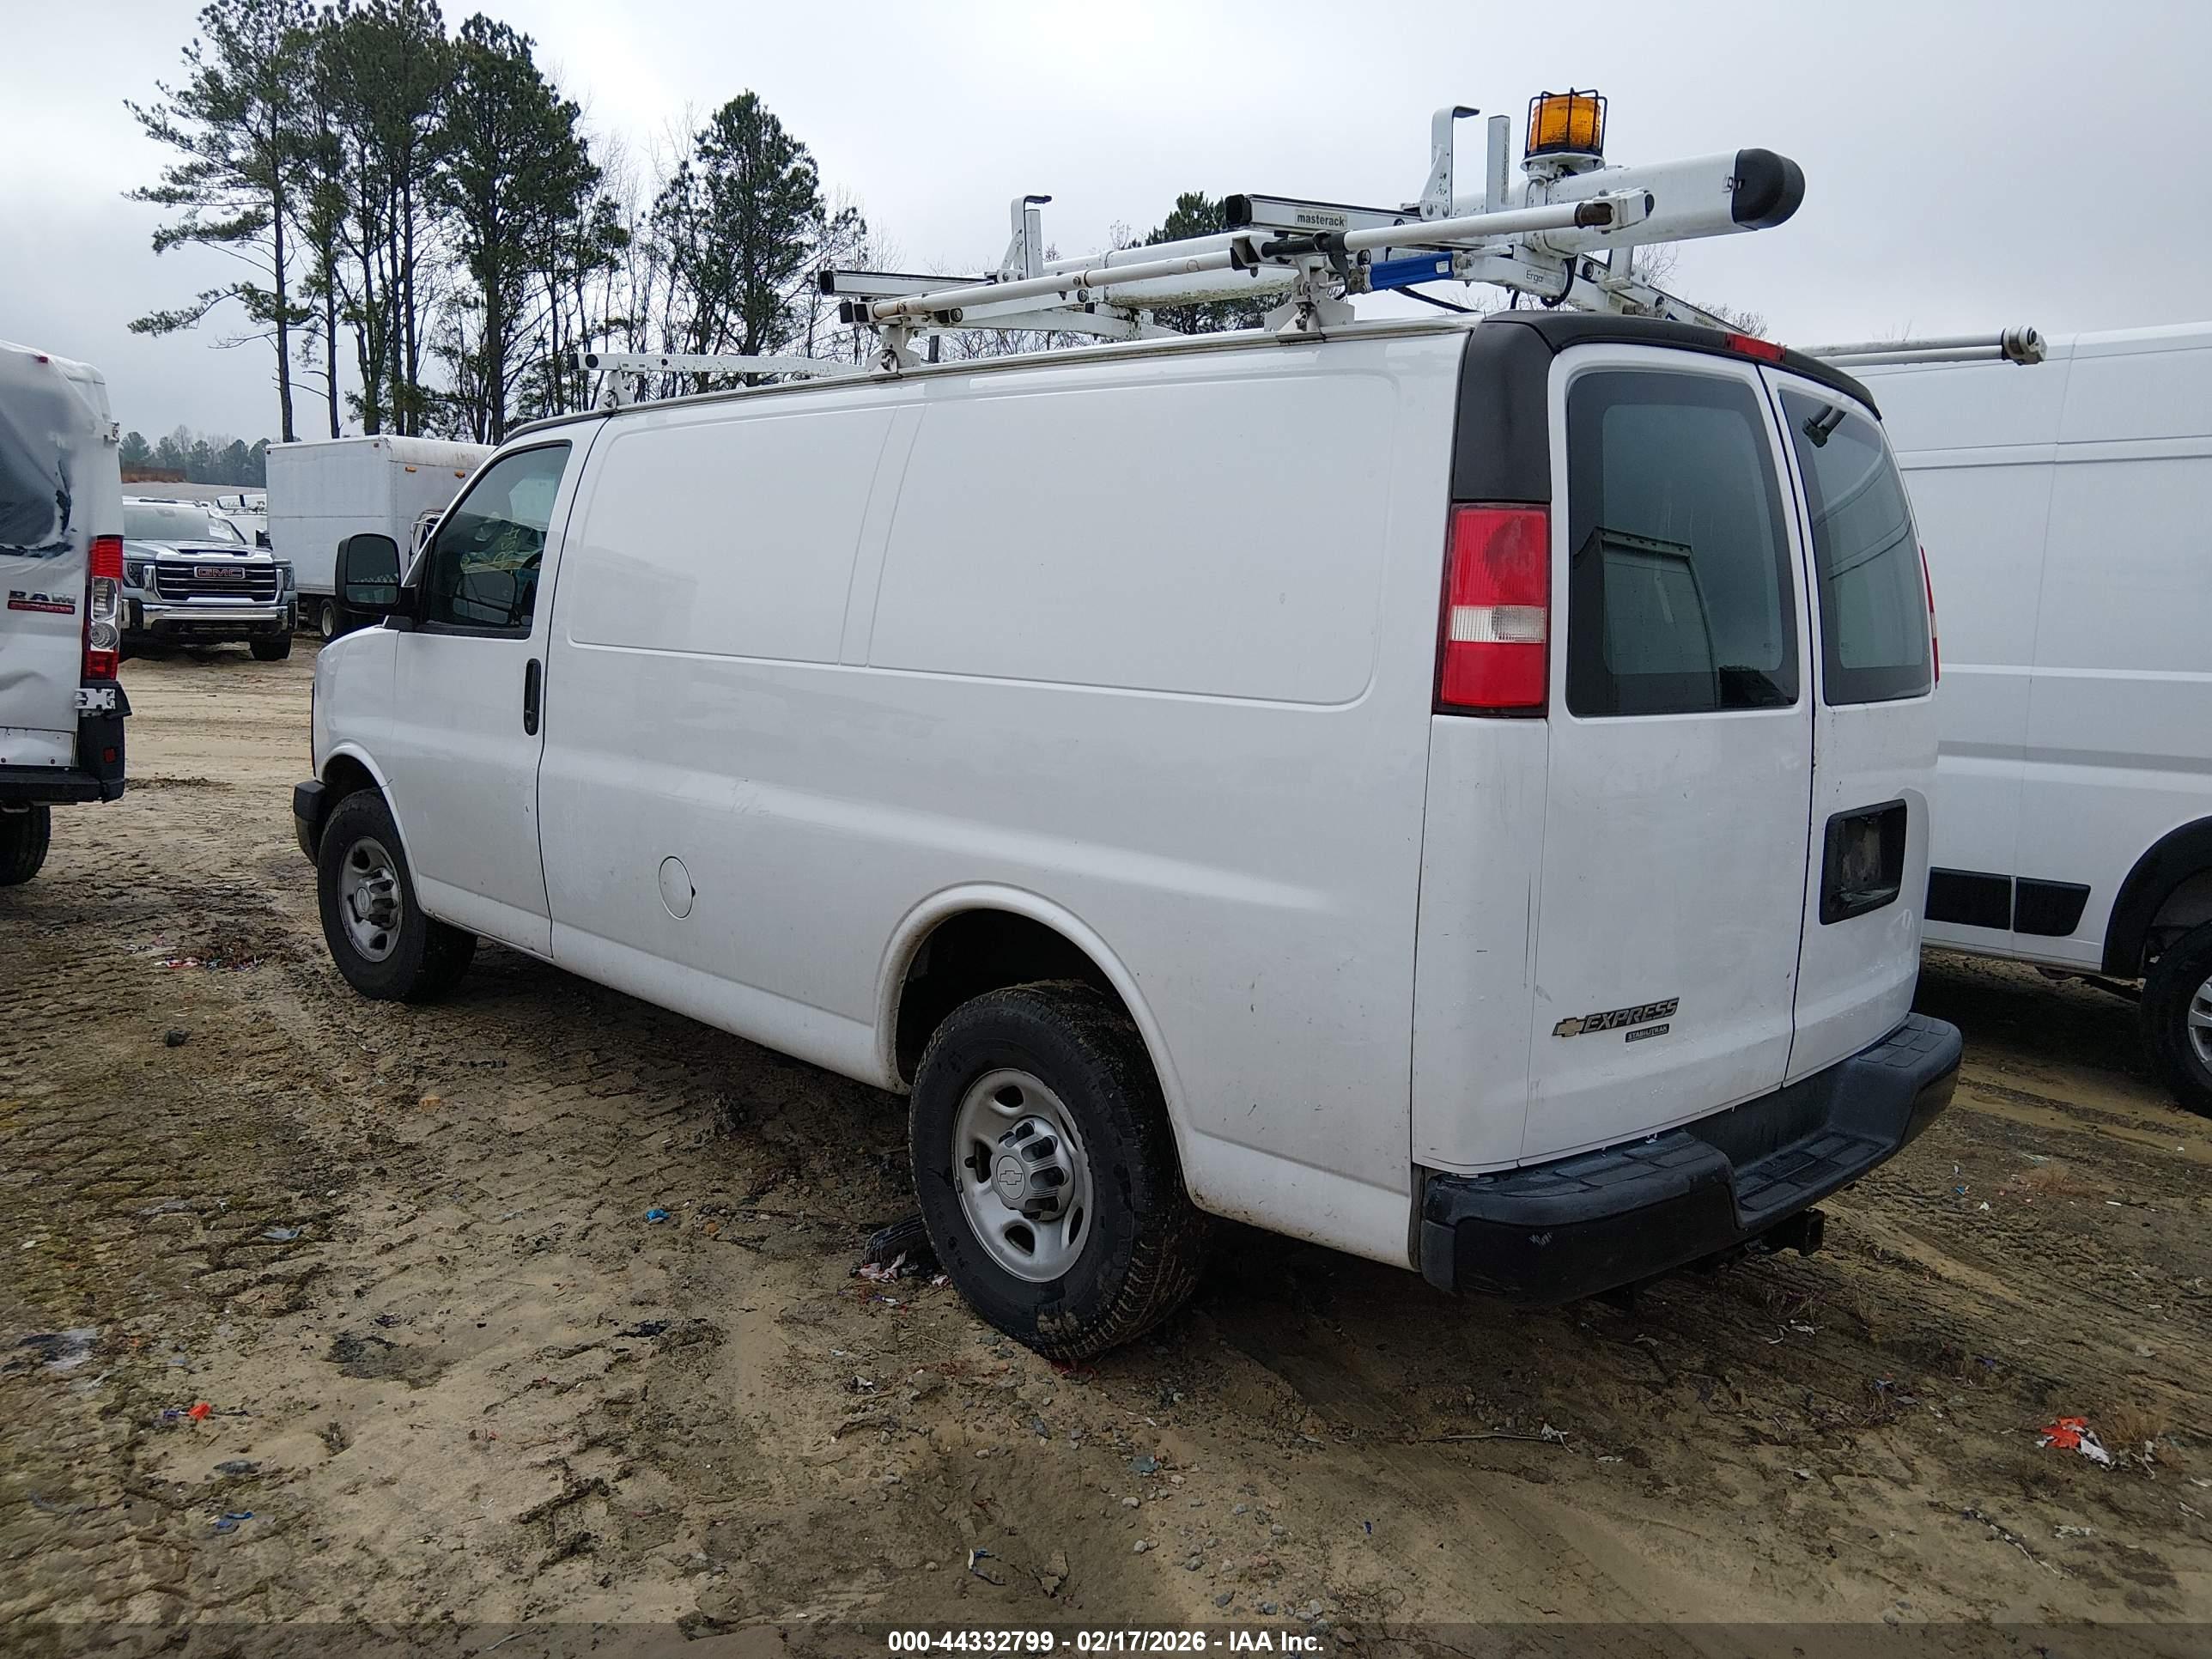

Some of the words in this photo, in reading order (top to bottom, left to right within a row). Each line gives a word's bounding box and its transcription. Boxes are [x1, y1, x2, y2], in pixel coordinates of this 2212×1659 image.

[1297, 214, 1345, 227] masterack
[1526, 270, 1544, 283] Ergo
[198, 568, 242, 578] GMC
[1583, 999, 1679, 1033] EXPRESS
